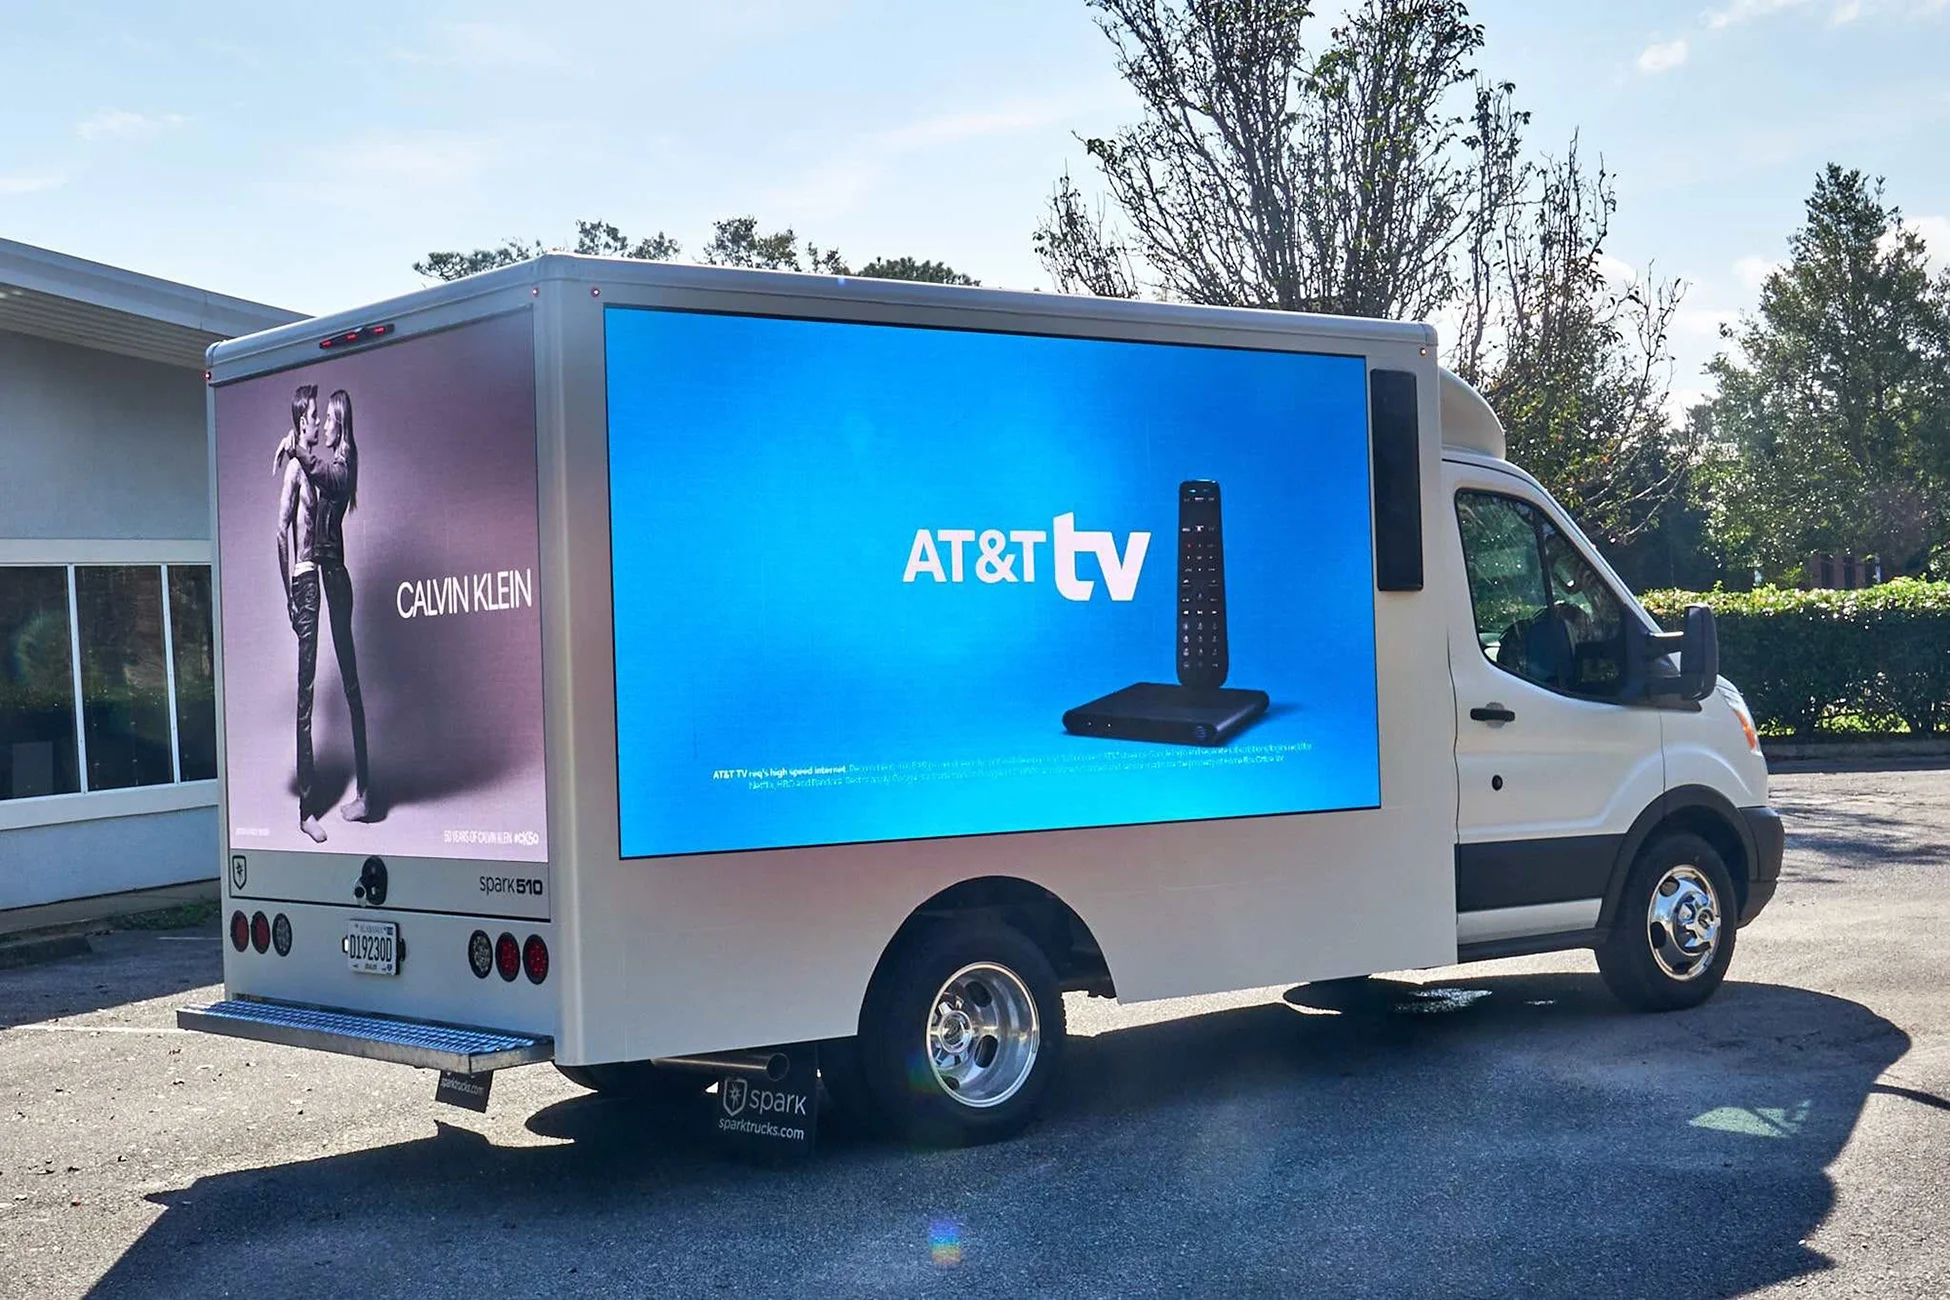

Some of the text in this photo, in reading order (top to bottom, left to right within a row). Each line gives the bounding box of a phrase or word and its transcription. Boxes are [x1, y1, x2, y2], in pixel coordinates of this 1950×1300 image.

[902, 511, 1152, 601] AT&T tv
[396, 568, 532, 619] CALVIN KLEIN
[712, 769, 735, 780] AT&T
[736, 768, 748, 779] TV
[769, 767, 788, 779] high
[789, 766, 813, 778] speed
[749, 1089, 807, 1115] spark
[719, 1118, 804, 1140] sparktrucks.com
